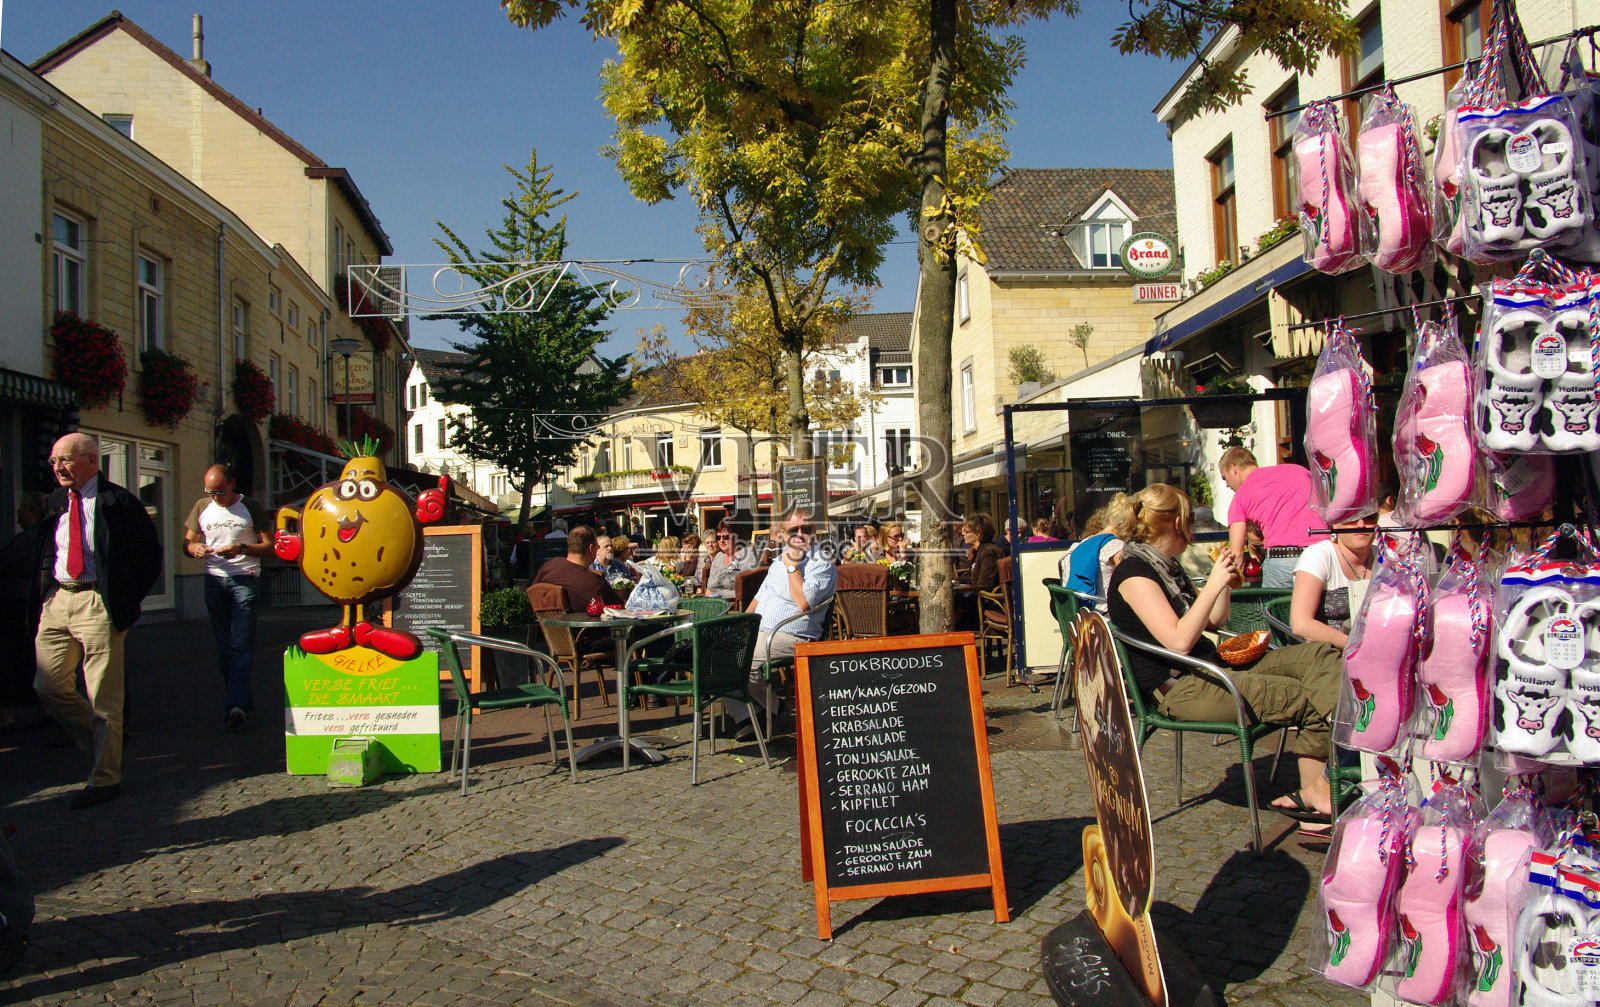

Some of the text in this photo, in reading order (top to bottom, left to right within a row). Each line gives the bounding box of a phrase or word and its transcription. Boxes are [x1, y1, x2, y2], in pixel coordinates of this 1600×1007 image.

[1482, 183, 1516, 193] Holland
[1535, 173, 1570, 190] Holland
[1129, 247, 1169, 261] Brand
[1139, 286, 1178, 300] DINNER
[335, 381, 373, 391] RESAURANT
[1498, 385, 1534, 393] Holland
[334, 654, 386, 673] GIELKE
[829, 654, 944, 675] STOKBROODJES
[304, 678, 352, 692] VERSE
[1514, 674, 1557, 686] Holland
[1579, 683, 1600, 693] Holl
[307, 692, 401, 705] DIE SMAAKT
[828, 682, 937, 701] HAM/KAAS/GEZOND
[375, 711, 418, 722] gesneden
[830, 701, 899, 718] EIERSALADE
[323, 723, 399, 736] vers gefrituurd
[831, 715, 905, 734] KRABSALADE
[832, 730, 907, 750] ZALMSALADE
[837, 763, 931, 783] GEROOKTE ZALM
[838, 778, 929, 797] SERRANO HAM
[841, 795, 900, 811] KIPFILET
[1091, 760, 1144, 841] MAGNUM
[845, 813, 927, 833] FOCACCIA'S
[845, 848, 933, 867] GEROOKTE ZALM
[847, 859, 922, 877] SERRANO HAM
[1570, 956, 1600, 964] SLIPPE
